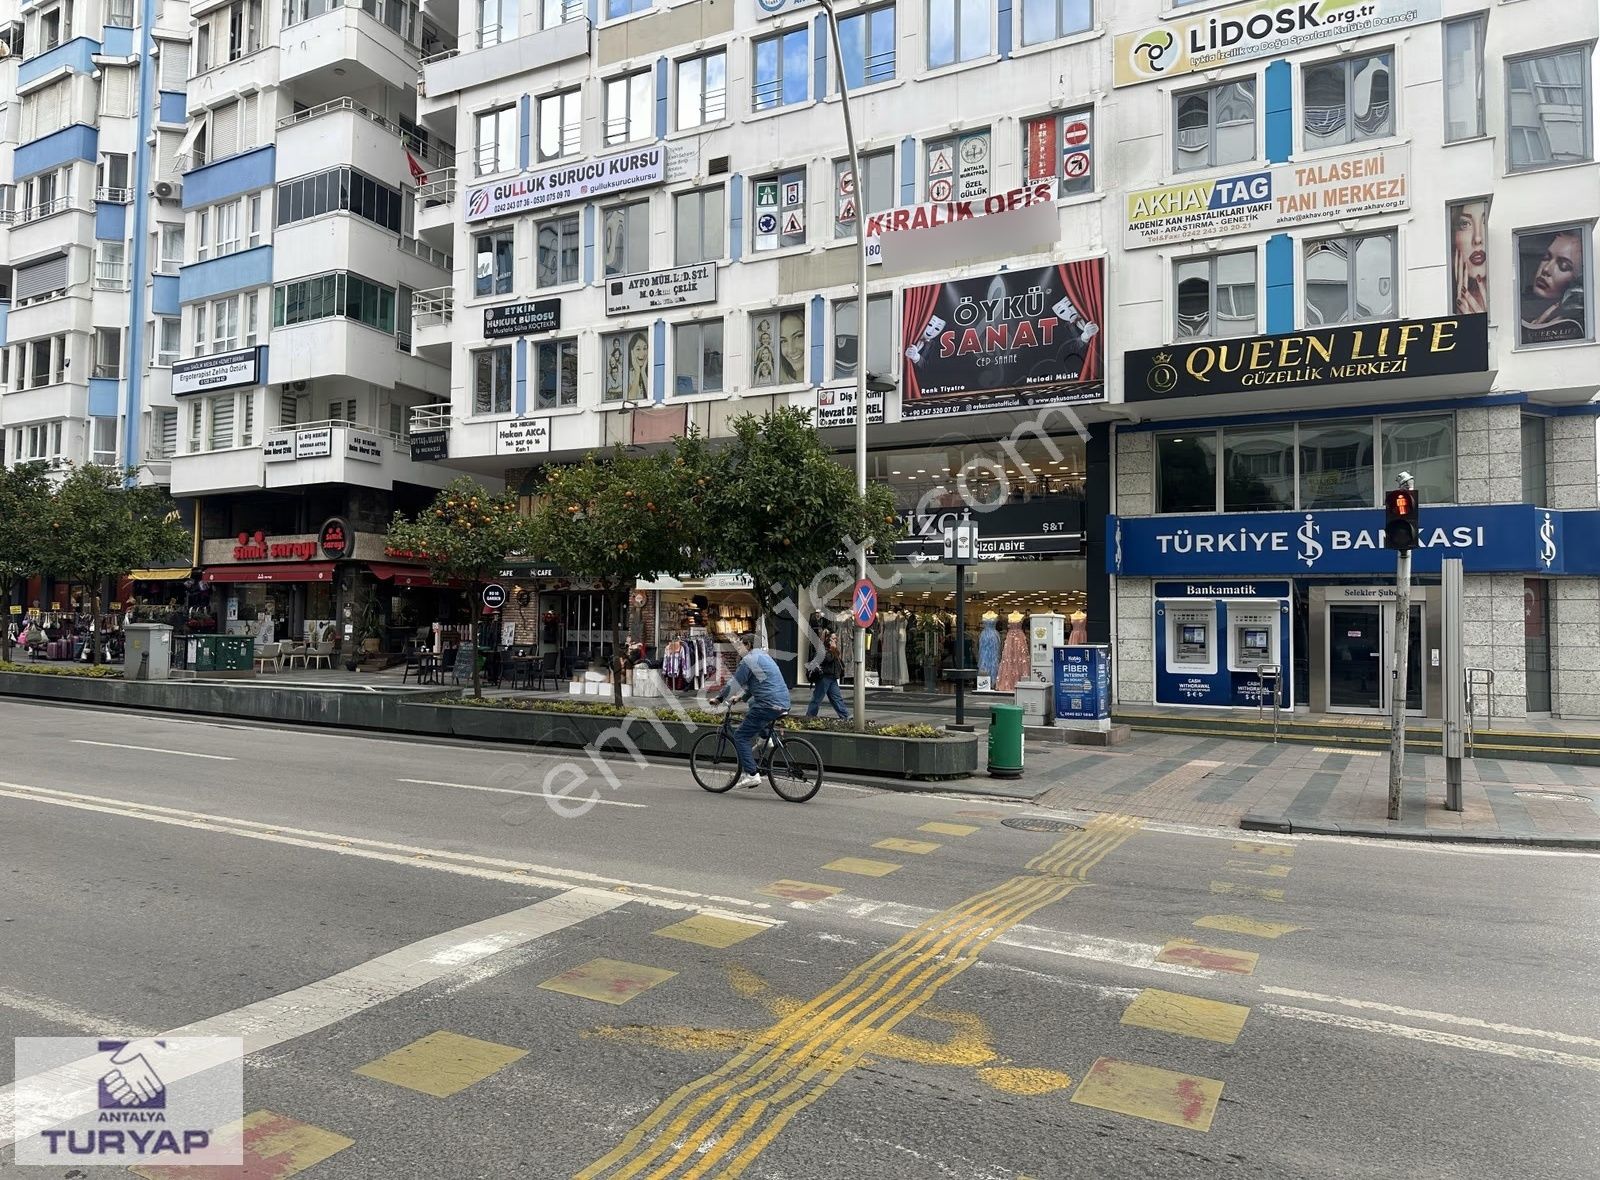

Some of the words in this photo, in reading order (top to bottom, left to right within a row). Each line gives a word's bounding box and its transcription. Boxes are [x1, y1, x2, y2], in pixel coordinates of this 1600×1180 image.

[1190, 54, 1217, 67] Lykia
[1217, 47, 1246, 61] İzcilik
[1246, 45, 1260, 54] ve
[1260, 38, 1289, 50] Doğa
[1290, 29, 1333, 45] Sporları
[1333, 20, 1373, 35] Kulübü
[1373, 10, 1418, 28] Derneği
[494, 176, 546, 201] GULLUK
[549, 162, 605, 189] SURUCU
[609, 150, 659, 175] KURSU
[963, 164, 985, 173] ANTALYA
[1295, 152, 1385, 187] TALASEMİ
[590, 173, 657, 193] gulluksurucukursu
[965, 180, 983, 189] ÖZEL
[960, 187, 987, 199] GÜLLÜK
[1276, 192, 1317, 214] TANI
[1323, 173, 1406, 208] MERKEZİ
[494, 203, 506, 213] 0242
[507, 201, 516, 211] 243
[533, 195, 546, 205] 0530
[1346, 199, 1405, 214] www.akhav.org.tr
[1128, 219, 1163, 231] AKDENİZ
[1165, 216, 1183, 226] KAN
[1184, 208, 1245, 224] HASTALIKLARI
[1247, 203, 1272, 214] VAKFI
[1164, 222, 1214, 233] ARAŞTIRMA
[1220, 213, 1259, 225] GENETİK
[628, 278, 650, 290] AYFO
[673, 281, 698, 296] ÇELİK
[504, 303, 536, 316] ETKİN
[953, 285, 1045, 327] ÖYKÜ
[486, 317, 517, 329] HUKUK
[518, 311, 555, 325] BÜROSU
[939, 316, 1059, 359] SANAT
[1185, 332, 1335, 383] QUEEN
[1351, 320, 1459, 360] LIFE
[976, 358, 991, 367] CEP
[994, 353, 1017, 365] SAHNE
[180, 370, 212, 383] Ergoterapist
[211, 367, 229, 376] Zeliha
[1026, 374, 1053, 383] Melodi
[1055, 371, 1079, 381] Müzik
[1241, 361, 1323, 387] GÜZELLİK
[1329, 356, 1408, 379] MERKEZİ
[839, 391, 853, 402] Diş
[921, 386, 938, 394] Renk
[940, 385, 965, 393] Tiyatro
[819, 407, 846, 418] Nevzat
[846, 403, 882, 416] DEREL
[499, 430, 523, 439] Hakan
[525, 427, 546, 437] AKCA
[1042, 521, 1064, 533] Ş&T
[998, 540, 1025, 551] ABİYE
[1156, 527, 1289, 553] TÜRKİYE
[1186, 585, 1257, 595] Bankamatik
[1063, 663, 1089, 673] FİBER
